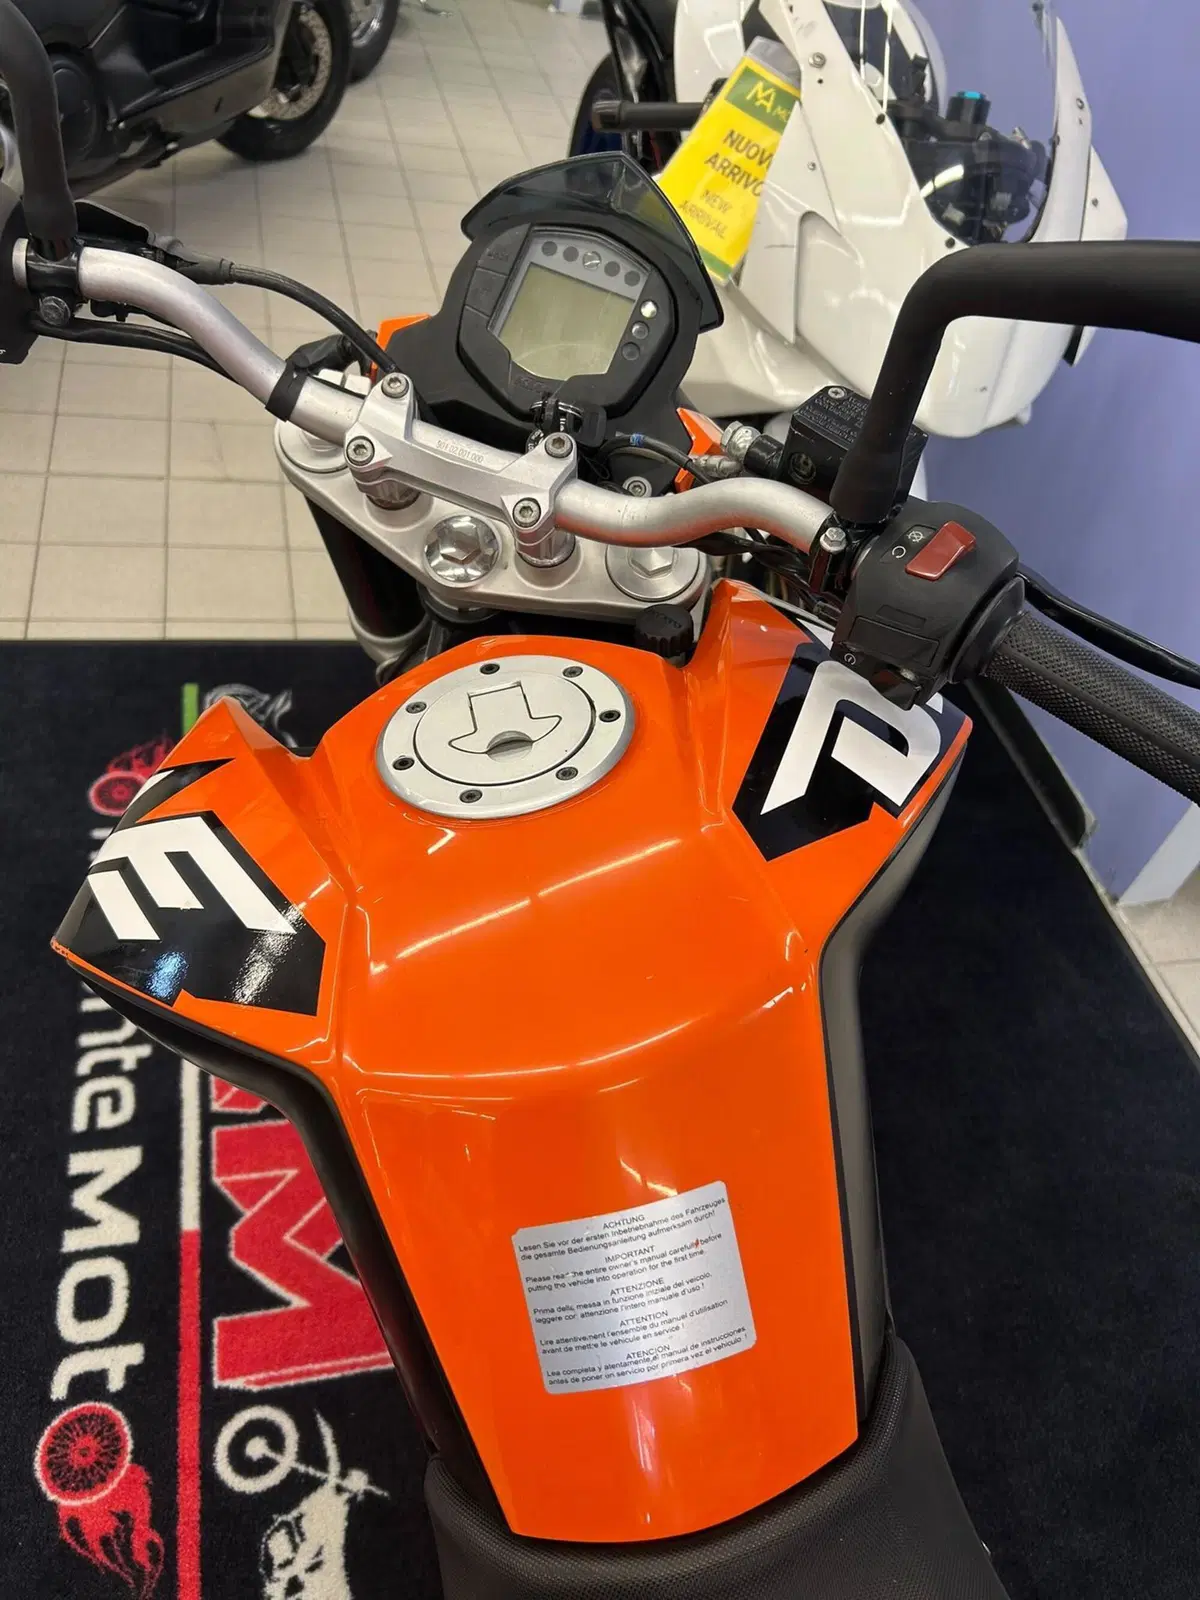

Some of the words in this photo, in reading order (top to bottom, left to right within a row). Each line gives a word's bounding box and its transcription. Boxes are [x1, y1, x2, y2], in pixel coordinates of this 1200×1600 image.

[702, 189, 733, 214] NEW
[678, 200, 728, 240] ARRIVAL
[518, 1243, 541, 1252] Lesen
[543, 1241, 555, 1249] Sie
[571, 1237, 583, 1245] der
[585, 1232, 610, 1242] ersten
[611, 1217, 669, 1237] Inbetriebnahme
[670, 1213, 684, 1221] des
[685, 1197, 726, 1215] Fahrzeuges
[533, 1249, 565, 1260] gesamte
[567, 1232, 647, 1255] Bedienungsanleitung
[648, 1218, 693, 1237] aufmerksam
[693, 1210, 715, 1223] durch!
[603, 1214, 645, 1230] ACHTUNG
[525, 1275, 551, 1283] Please
[585, 1265, 607, 1275] entire
[608, 1258, 638, 1272] owner's
[639, 1249, 667, 1263] manual
[700, 1232, 722, 1245] before
[604, 1245, 655, 1263] IMPORTANT
[527, 1284, 552, 1292] putting
[567, 1277, 594, 1287] vehicle
[596, 1273, 610, 1282] into
[611, 1266, 647, 1280] operation
[648, 1262, 659, 1270] for
[660, 1258, 672, 1267] the
[673, 1253, 688, 1263] first
[610, 1277, 664, 1296] ATTENZIONE
[533, 1307, 555, 1315] Prima
[576, 1301, 601, 1309] messa
[611, 1293, 644, 1304] funzione
[646, 1285, 671, 1296] iniziale
[673, 1280, 684, 1289] del
[535, 1315, 562, 1324] leggere
[580, 1307, 619, 1318] attenzione
[647, 1293, 679, 1304] manuale
[681, 1286, 700, 1296] d'uso
[660, 1313, 687, 1325] manuel
[689, 1299, 728, 1317] d'utilisation
[619, 1310, 668, 1327] ATTENTION
[654, 1325, 679, 1337] service
[562, 1366, 596, 1375] completa
[661, 1345, 688, 1358] manual
[701, 1326, 746, 1346] instrucciones
[549, 1377, 568, 1385] antes
[581, 1373, 603, 1382] poner
[616, 1366, 645, 1377] servicio
[647, 1364, 659, 1372] por
[660, 1356, 689, 1368] primera
[690, 1351, 704, 1359] vez
